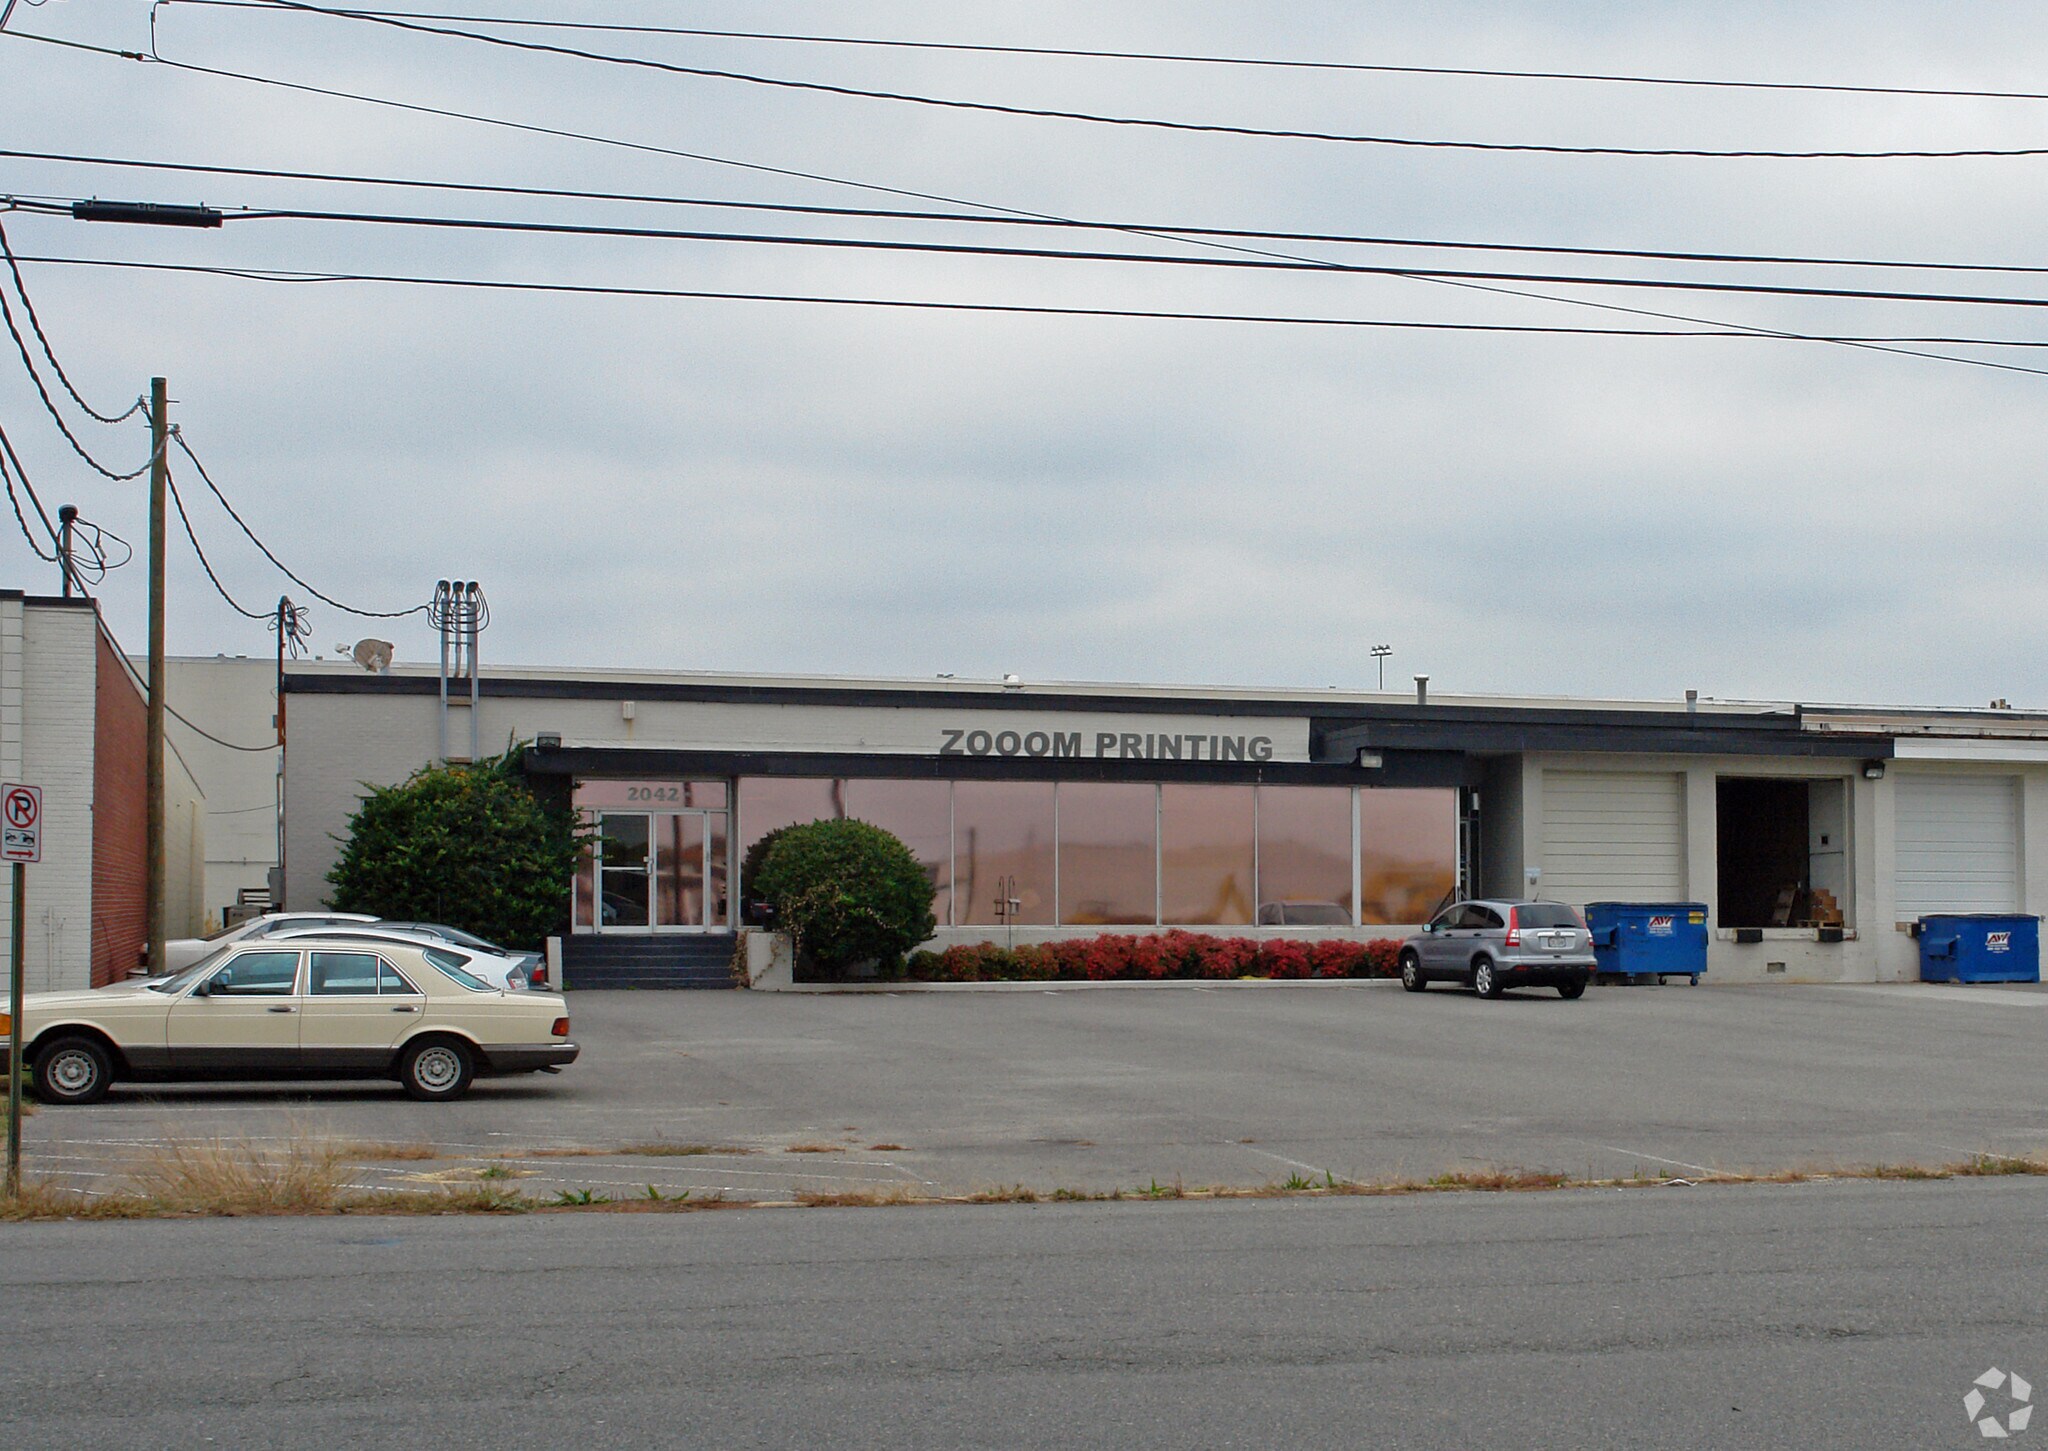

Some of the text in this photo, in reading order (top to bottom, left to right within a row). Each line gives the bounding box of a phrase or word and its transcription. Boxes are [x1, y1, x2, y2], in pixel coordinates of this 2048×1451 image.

[939, 729, 1273, 762] ZOOOM PRINTING
[628, 786, 680, 801] 2042
